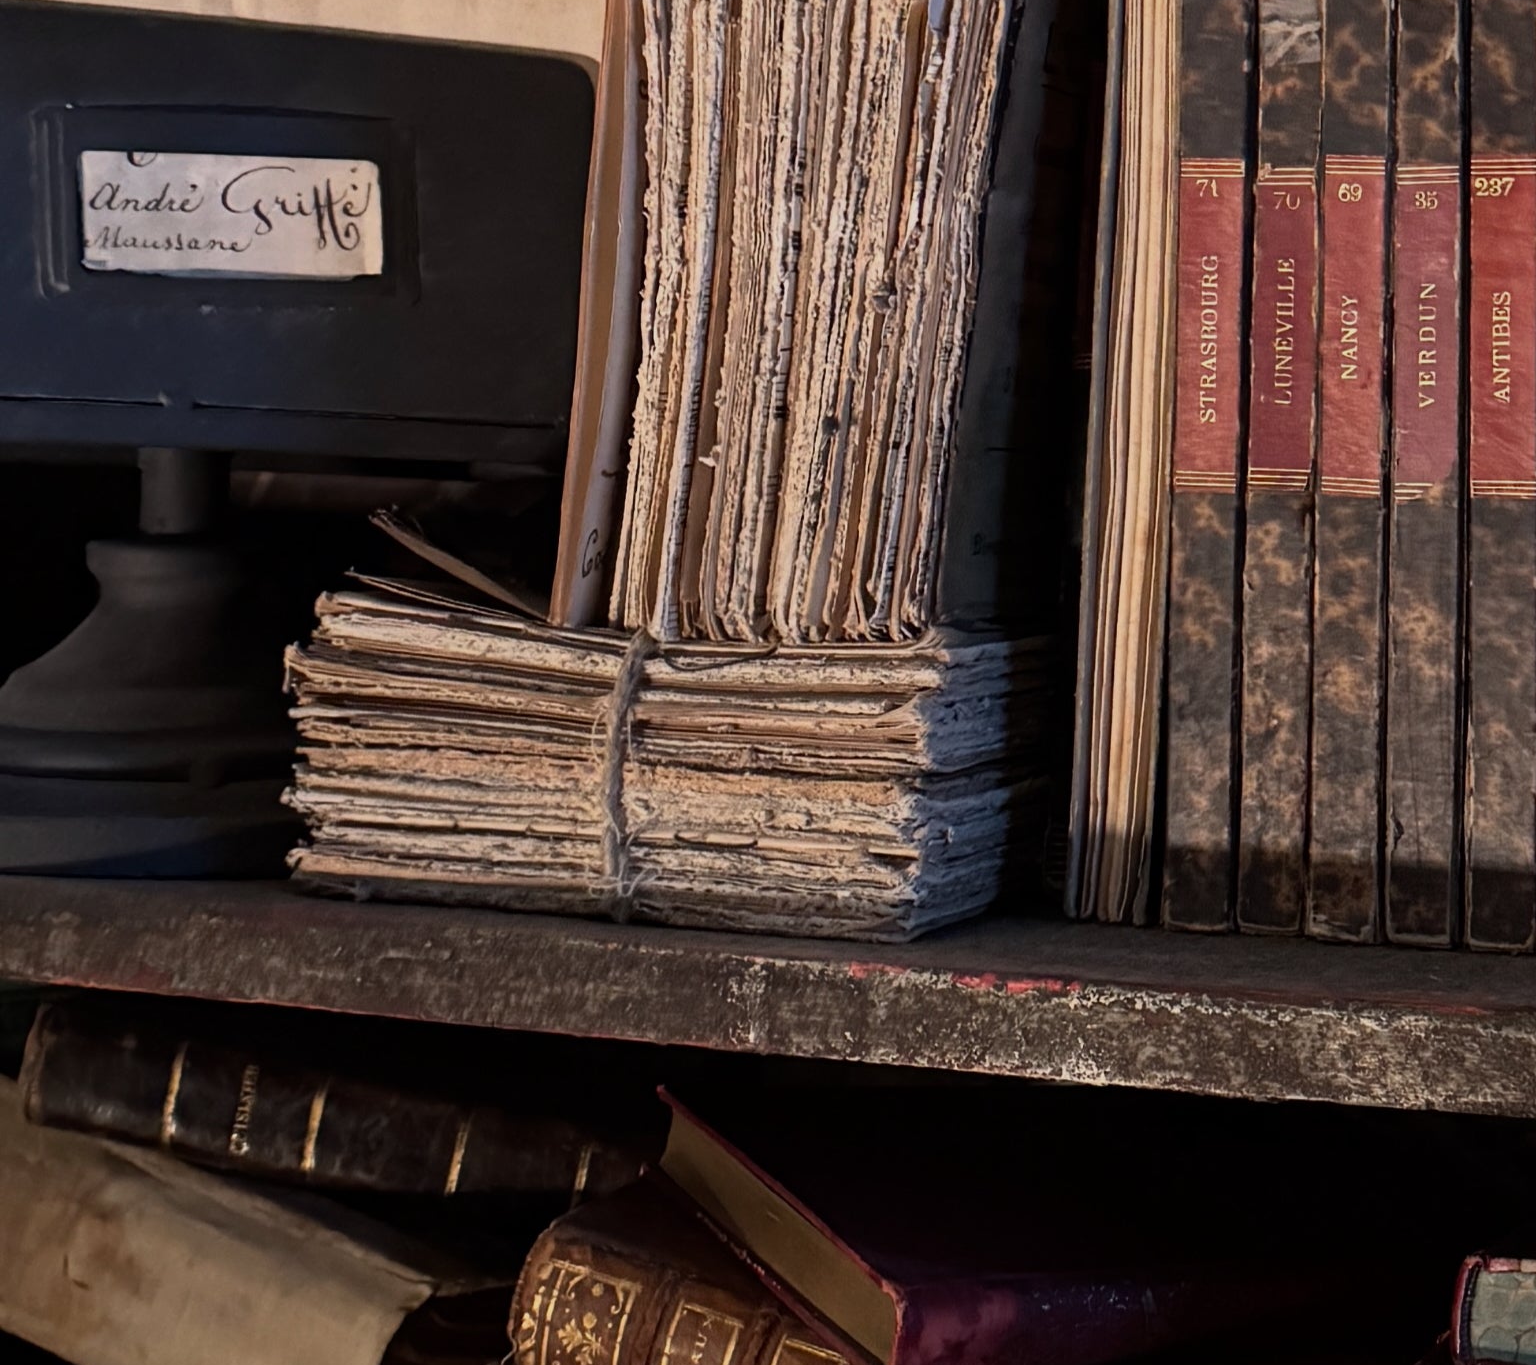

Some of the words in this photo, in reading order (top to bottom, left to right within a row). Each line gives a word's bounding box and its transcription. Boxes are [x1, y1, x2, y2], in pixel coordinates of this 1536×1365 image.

[1196, 179, 1219, 198] 71
[1337, 182, 1362, 203] 69
[1474, 177, 1515, 196] 237
[1273, 191, 1300, 210] 70
[1414, 191, 1438, 210] 35
[1200, 255, 1219, 423] STRASBOURG
[1340, 295, 1359, 380] NANCY
[1418, 283, 1438, 409] VERDUN
[1492, 291, 1512, 404] ANTIBES
